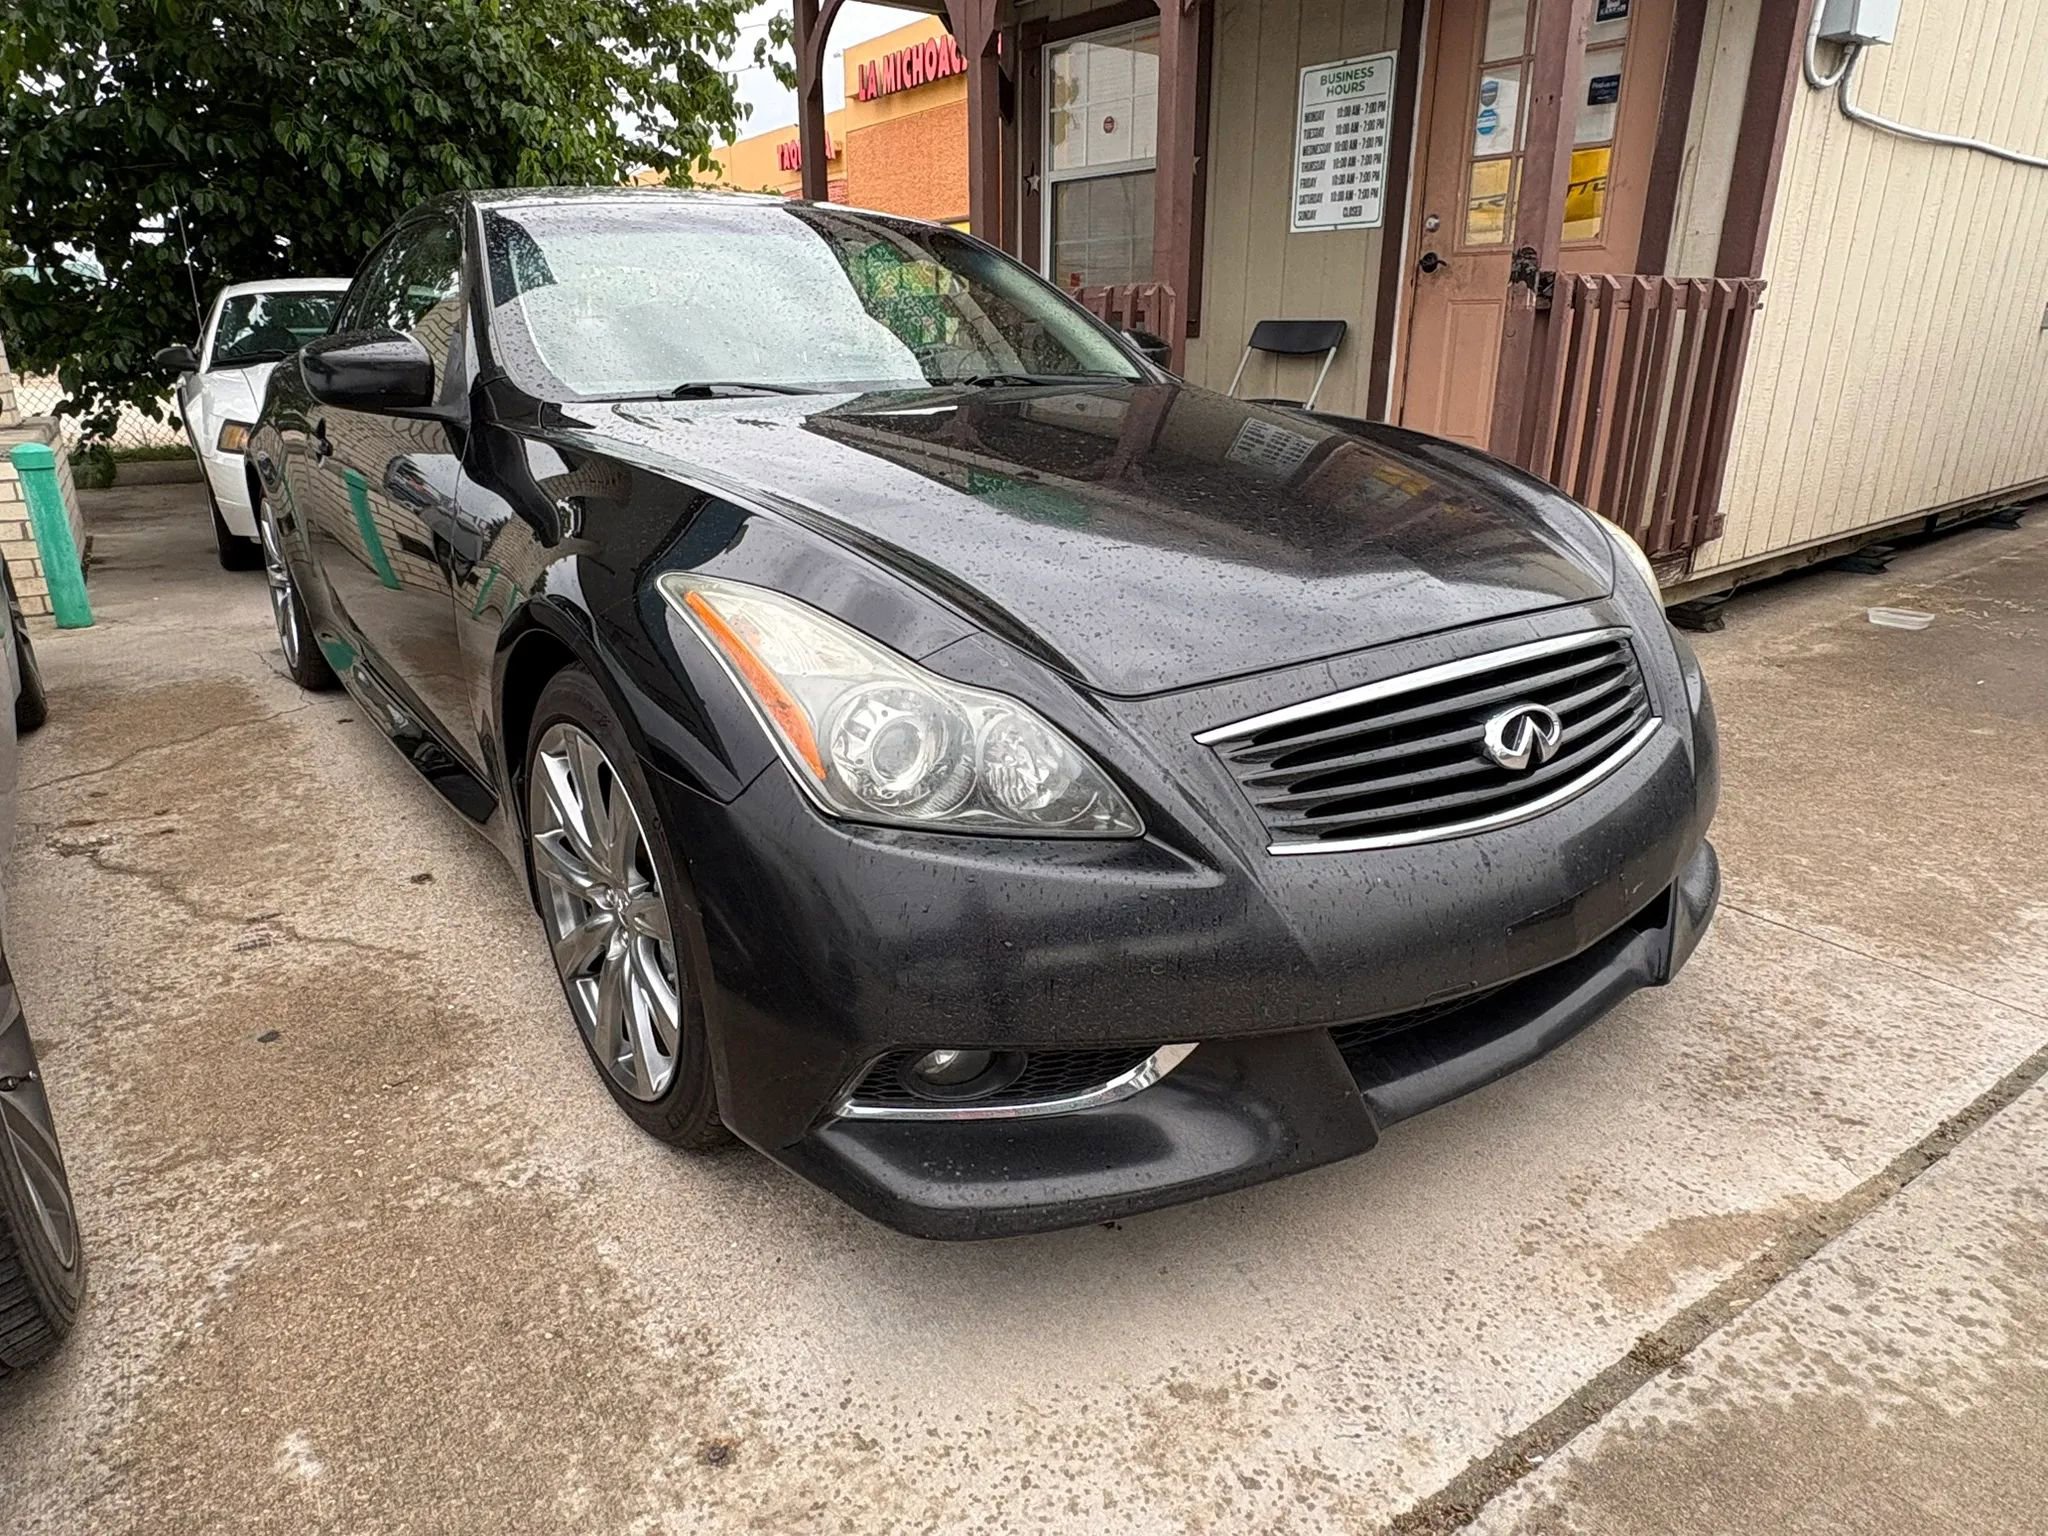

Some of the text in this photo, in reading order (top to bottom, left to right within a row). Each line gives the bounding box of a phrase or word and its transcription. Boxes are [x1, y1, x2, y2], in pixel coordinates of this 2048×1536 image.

[858, 60, 878, 101] LA
[1320, 66, 1374, 86] BUSINESS
[1326, 80, 1365, 97] HOURS
[1343, 205, 1362, 218] CLOSED
